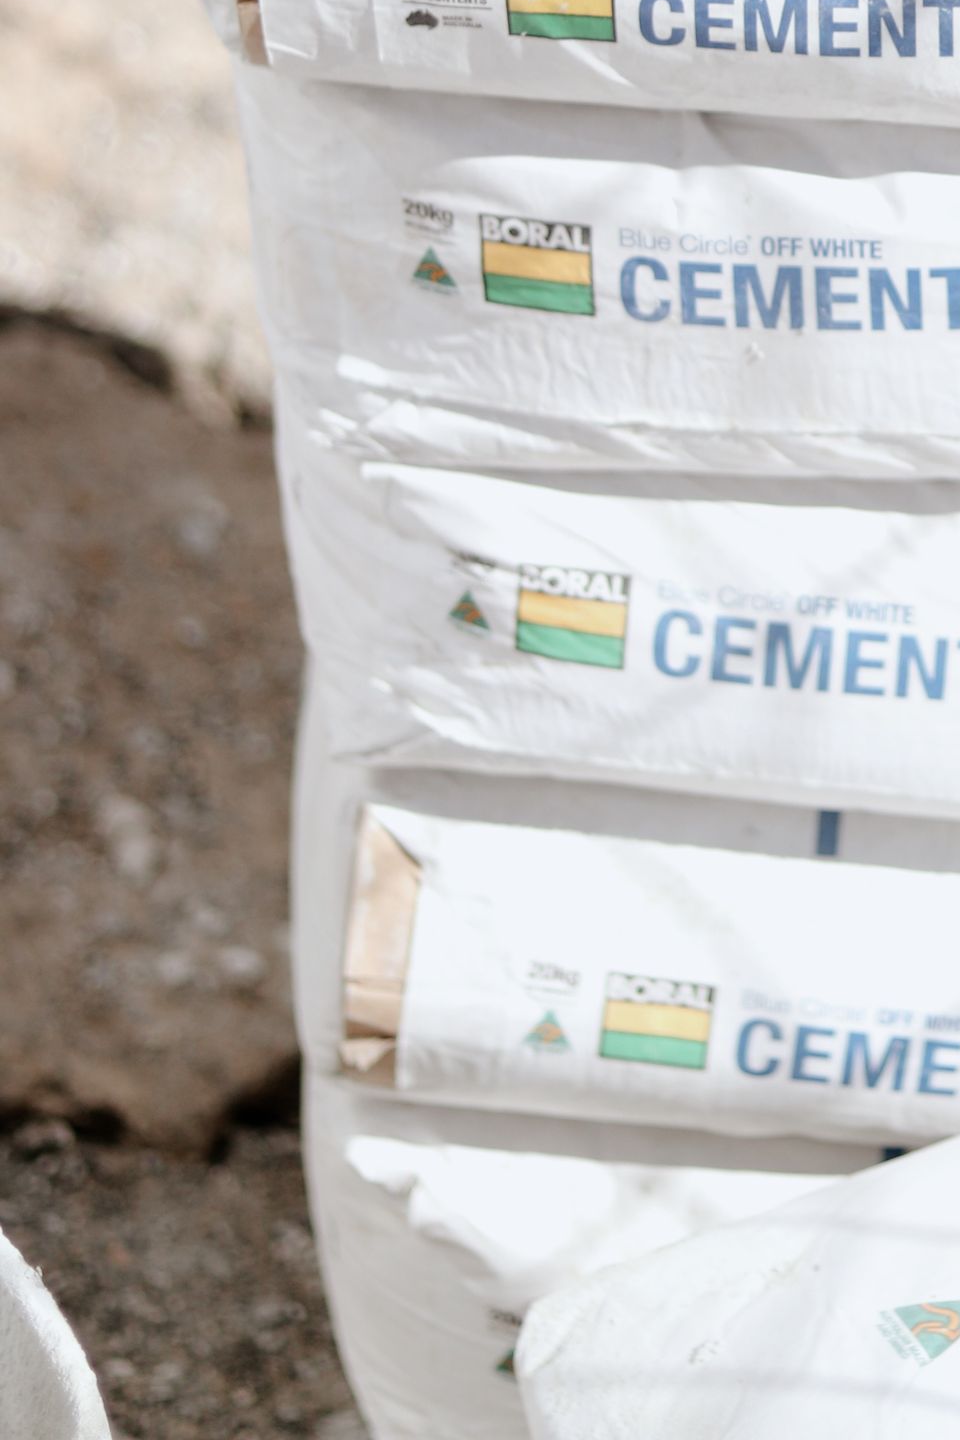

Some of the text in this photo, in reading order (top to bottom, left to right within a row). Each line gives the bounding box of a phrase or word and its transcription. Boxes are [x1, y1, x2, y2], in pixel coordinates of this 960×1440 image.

[481, 215, 590, 250] BORAL
[618, 227, 883, 260] Blue Circle OFF WHITE
[520, 566, 629, 601] BORAL
[795, 595, 839, 617] OFF
[845, 600, 917, 625] WHITE
